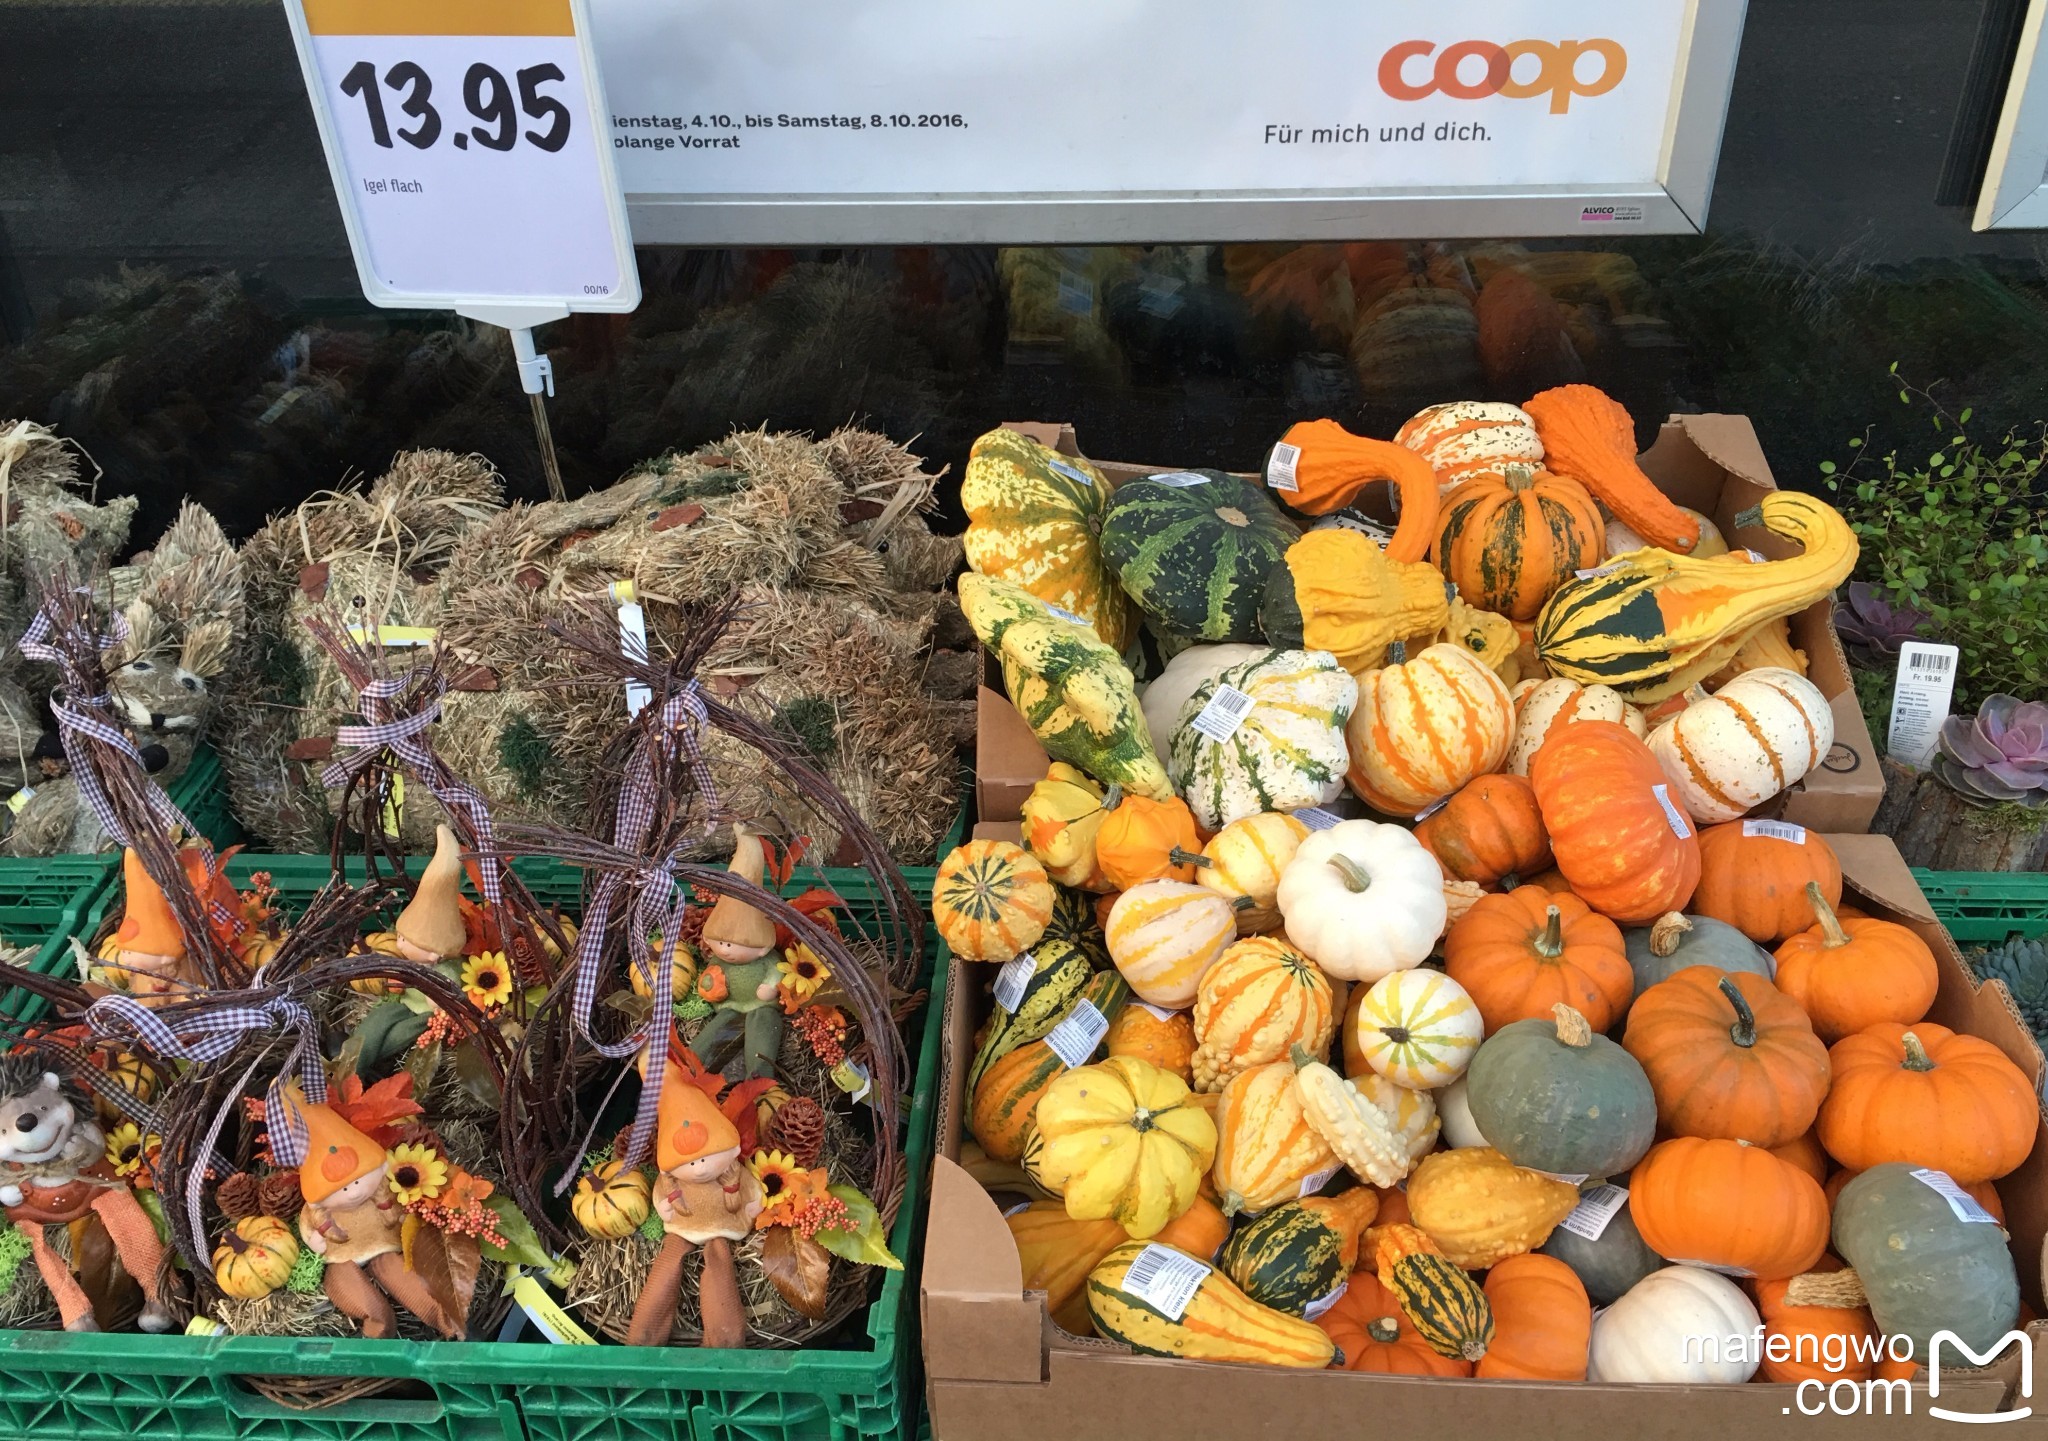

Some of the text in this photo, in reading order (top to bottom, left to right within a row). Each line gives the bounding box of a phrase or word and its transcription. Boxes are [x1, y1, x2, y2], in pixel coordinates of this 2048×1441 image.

[1378, 38, 1627, 115] coop
[340, 61, 571, 153] 13.95
[612, 114, 969, 130] ienstag, 4.10., bis Samstag, 8.10.2016,
[1264, 121, 1492, 144] Für mich und dich.
[614, 135, 741, 150] olange Vorrat
[363, 178, 423, 196] Igel flach
[1583, 206, 1614, 214] ALVICO
[583, 284, 609, 295] 00/16
[1913, 673, 1942, 683] Fr. 19.95
[1171, 1268, 1206, 1314] Kollektion klein
